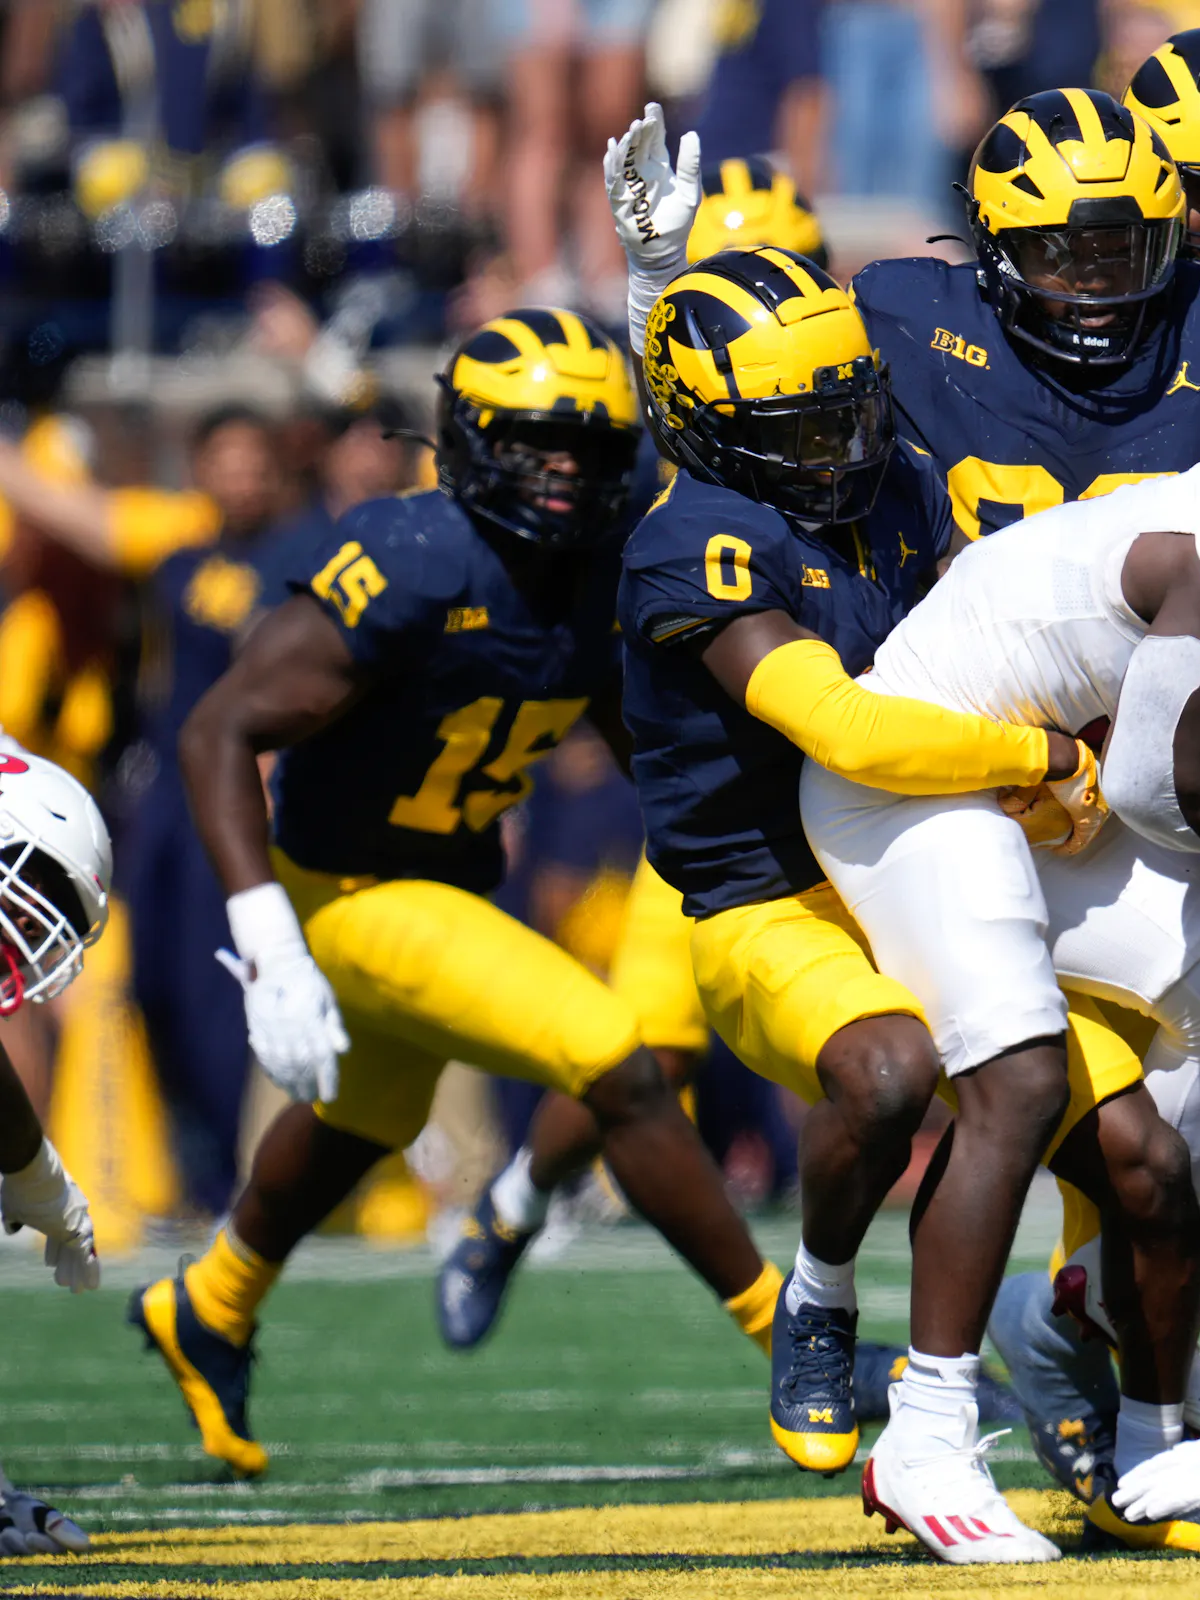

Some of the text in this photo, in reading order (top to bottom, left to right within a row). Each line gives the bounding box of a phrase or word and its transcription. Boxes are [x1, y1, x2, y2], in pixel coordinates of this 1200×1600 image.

[624, 146, 660, 245] MICHIGAN
[1073, 335, 1109, 348] Rddell
[837, 363, 854, 380] M
[311, 540, 388, 629] 15
[388, 696, 591, 835] 15
[807, 1407, 834, 1424] M
